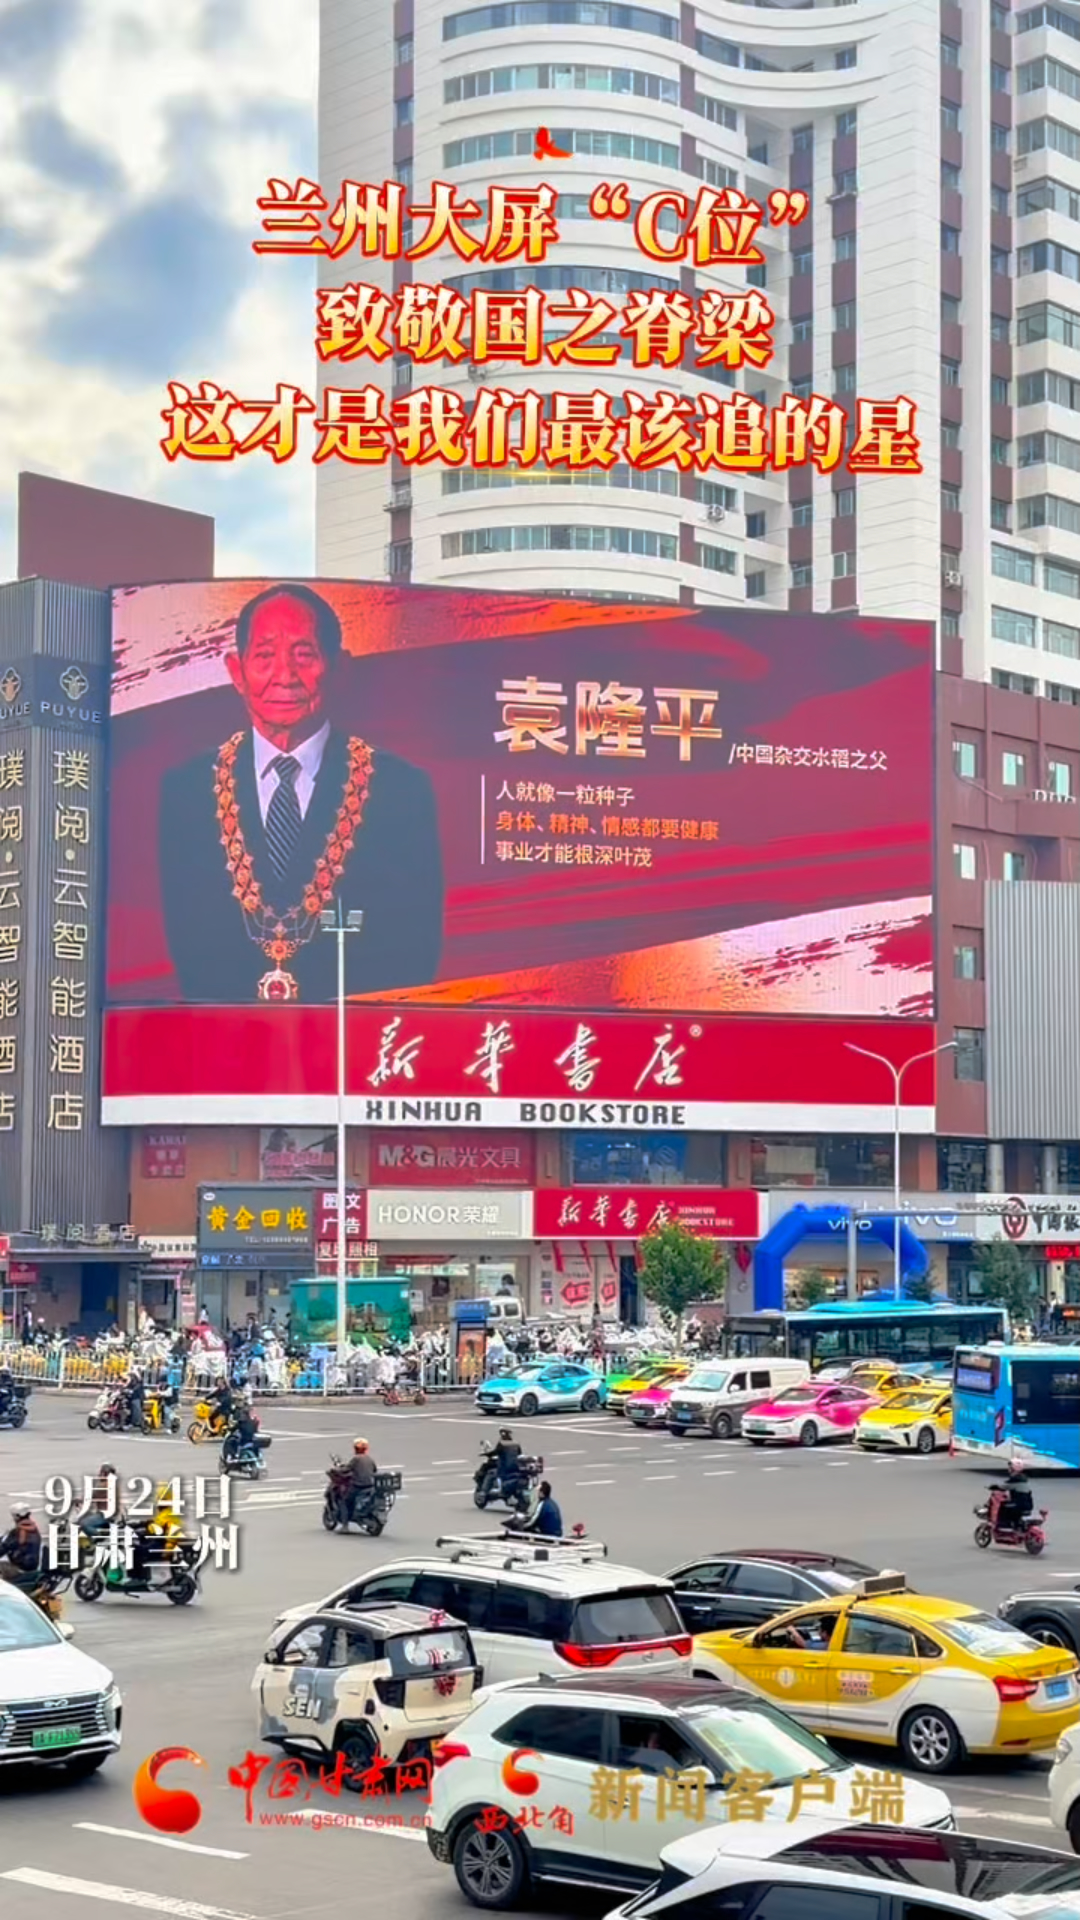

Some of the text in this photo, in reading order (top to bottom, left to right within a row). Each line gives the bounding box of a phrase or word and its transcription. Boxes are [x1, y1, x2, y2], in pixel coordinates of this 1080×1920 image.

[41, 701, 102, 723] PUYUE
[493, 676, 723, 761] 袁隆平
[496, 780, 635, 807] 人就像一粒种子
[496, 811, 719, 841] 身体、精神、情感都要健康
[496, 841, 653, 868] 事业才能根深叶茂
[47, 749, 90, 1131] 璞阅·云智能酒店
[366, 1099, 686, 1125] XINHUA BOOKSTORE
[207, 1205, 308, 1232] 黄金回收
